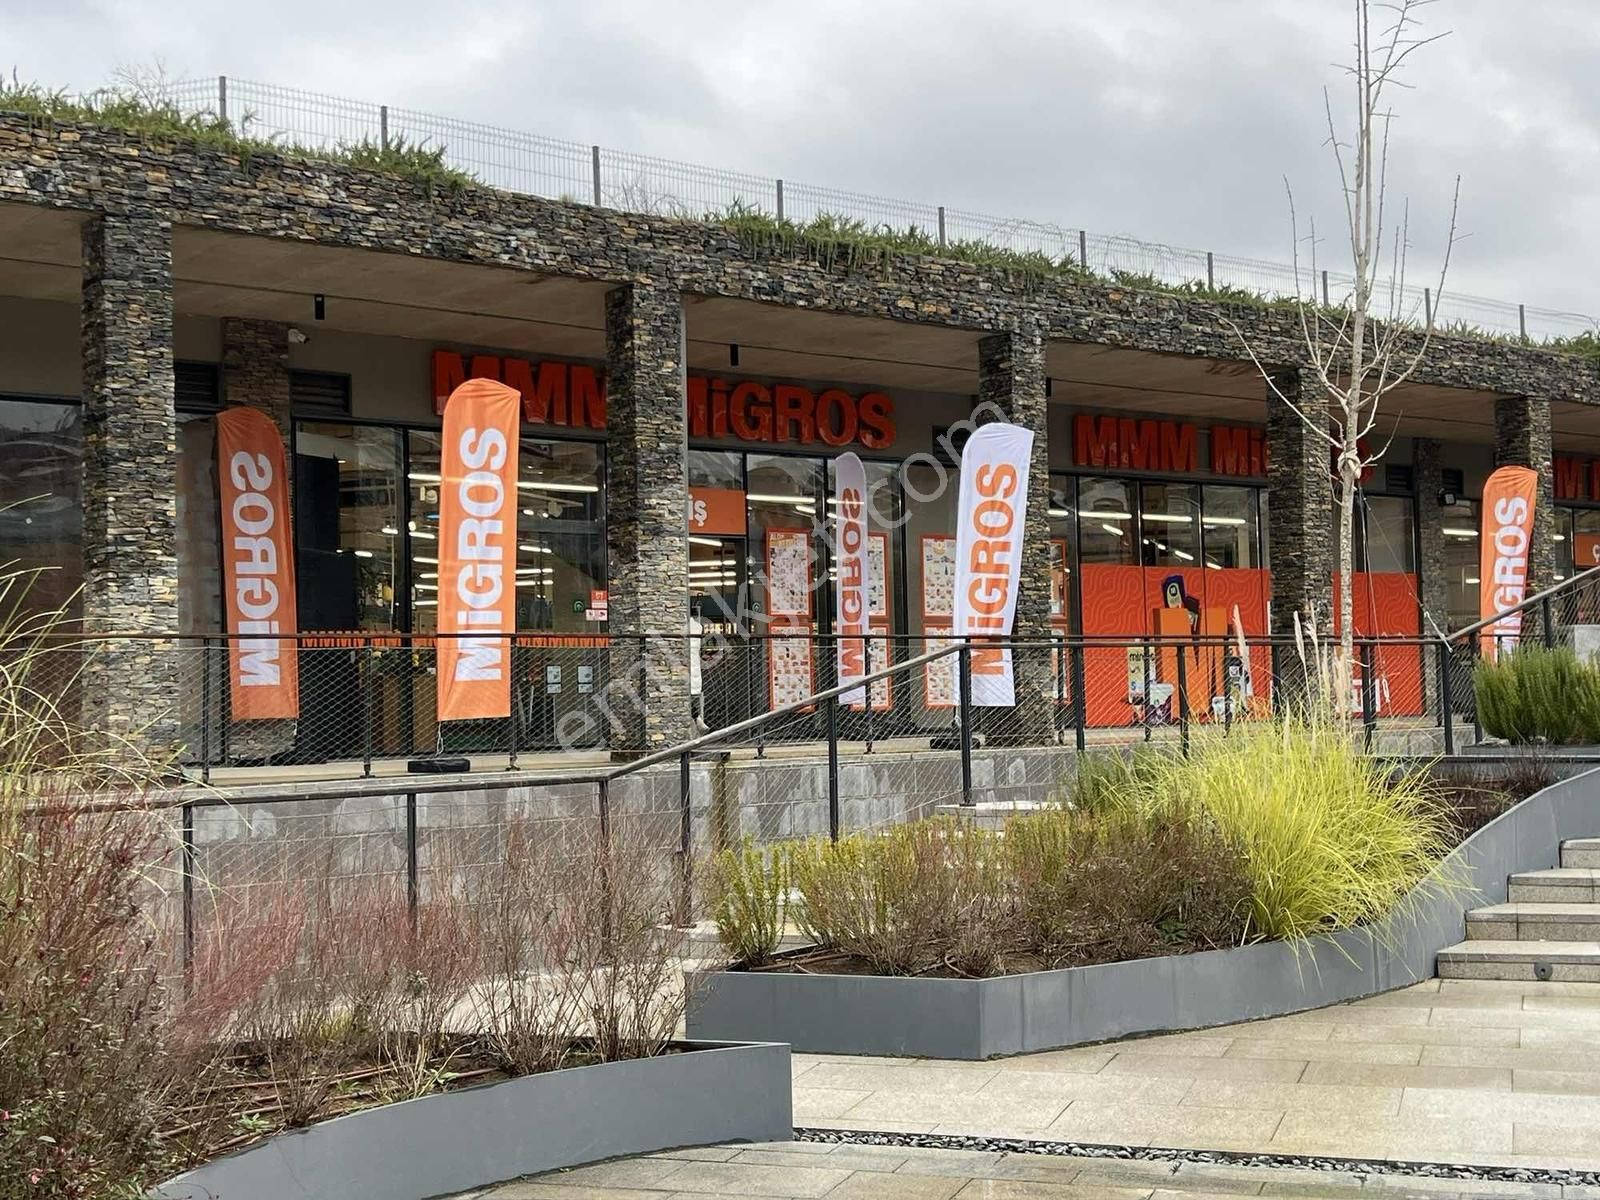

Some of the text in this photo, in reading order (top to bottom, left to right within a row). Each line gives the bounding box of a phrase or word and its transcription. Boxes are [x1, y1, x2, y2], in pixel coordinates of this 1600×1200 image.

[1076, 414, 1198, 473] MMM
[456, 427, 508, 682] MiGROS
[967, 463, 1018, 676] MiGROS
